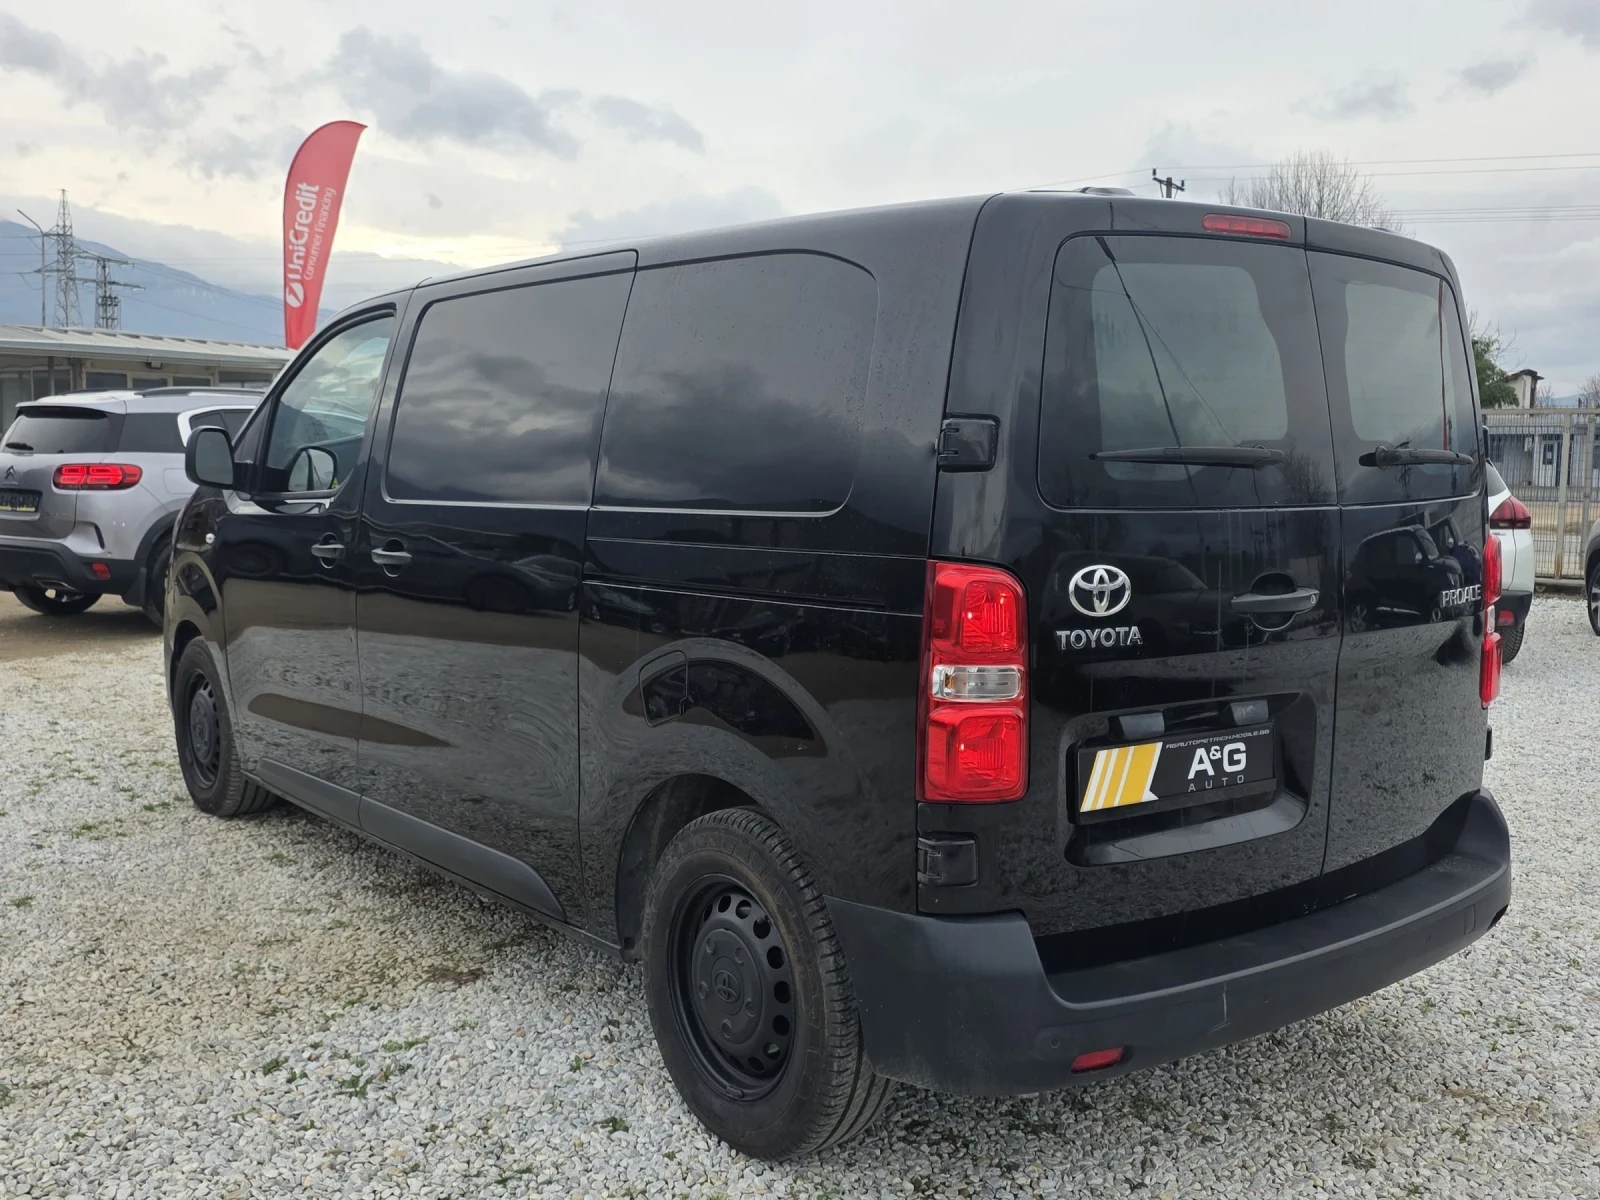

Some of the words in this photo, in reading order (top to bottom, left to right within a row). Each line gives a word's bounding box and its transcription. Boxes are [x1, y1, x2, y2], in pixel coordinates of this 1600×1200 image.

[288, 181, 319, 280] UniCredit
[1442, 584, 1481, 607] PROACE
[1055, 626, 1143, 650] TOYOTA
[1187, 741, 1247, 780] A&G
[1188, 774, 1245, 793] AUTO
